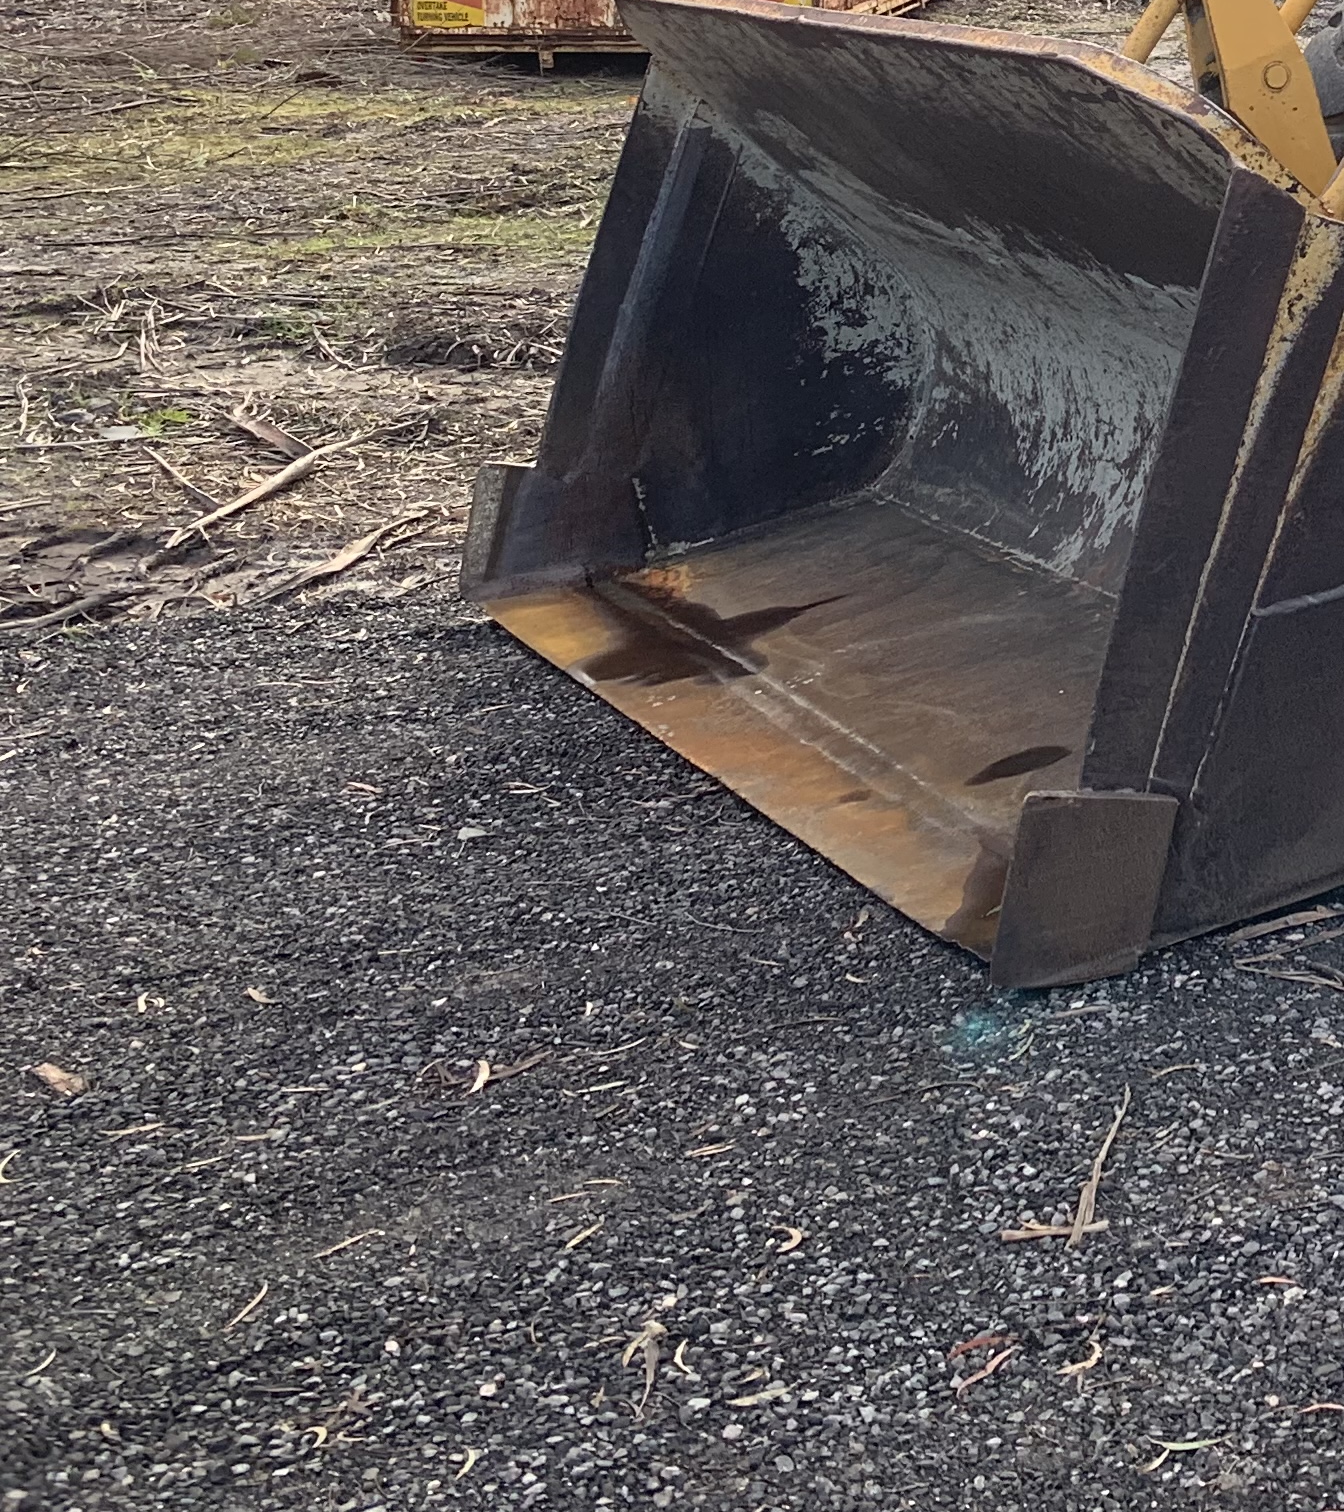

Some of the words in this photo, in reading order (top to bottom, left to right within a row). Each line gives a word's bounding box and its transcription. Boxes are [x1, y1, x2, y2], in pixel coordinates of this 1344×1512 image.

[417, 1, 447, 10] OVERTAKE
[417, 12, 442, 21] TURNING
[444, 12, 469, 21] VEHICLE
